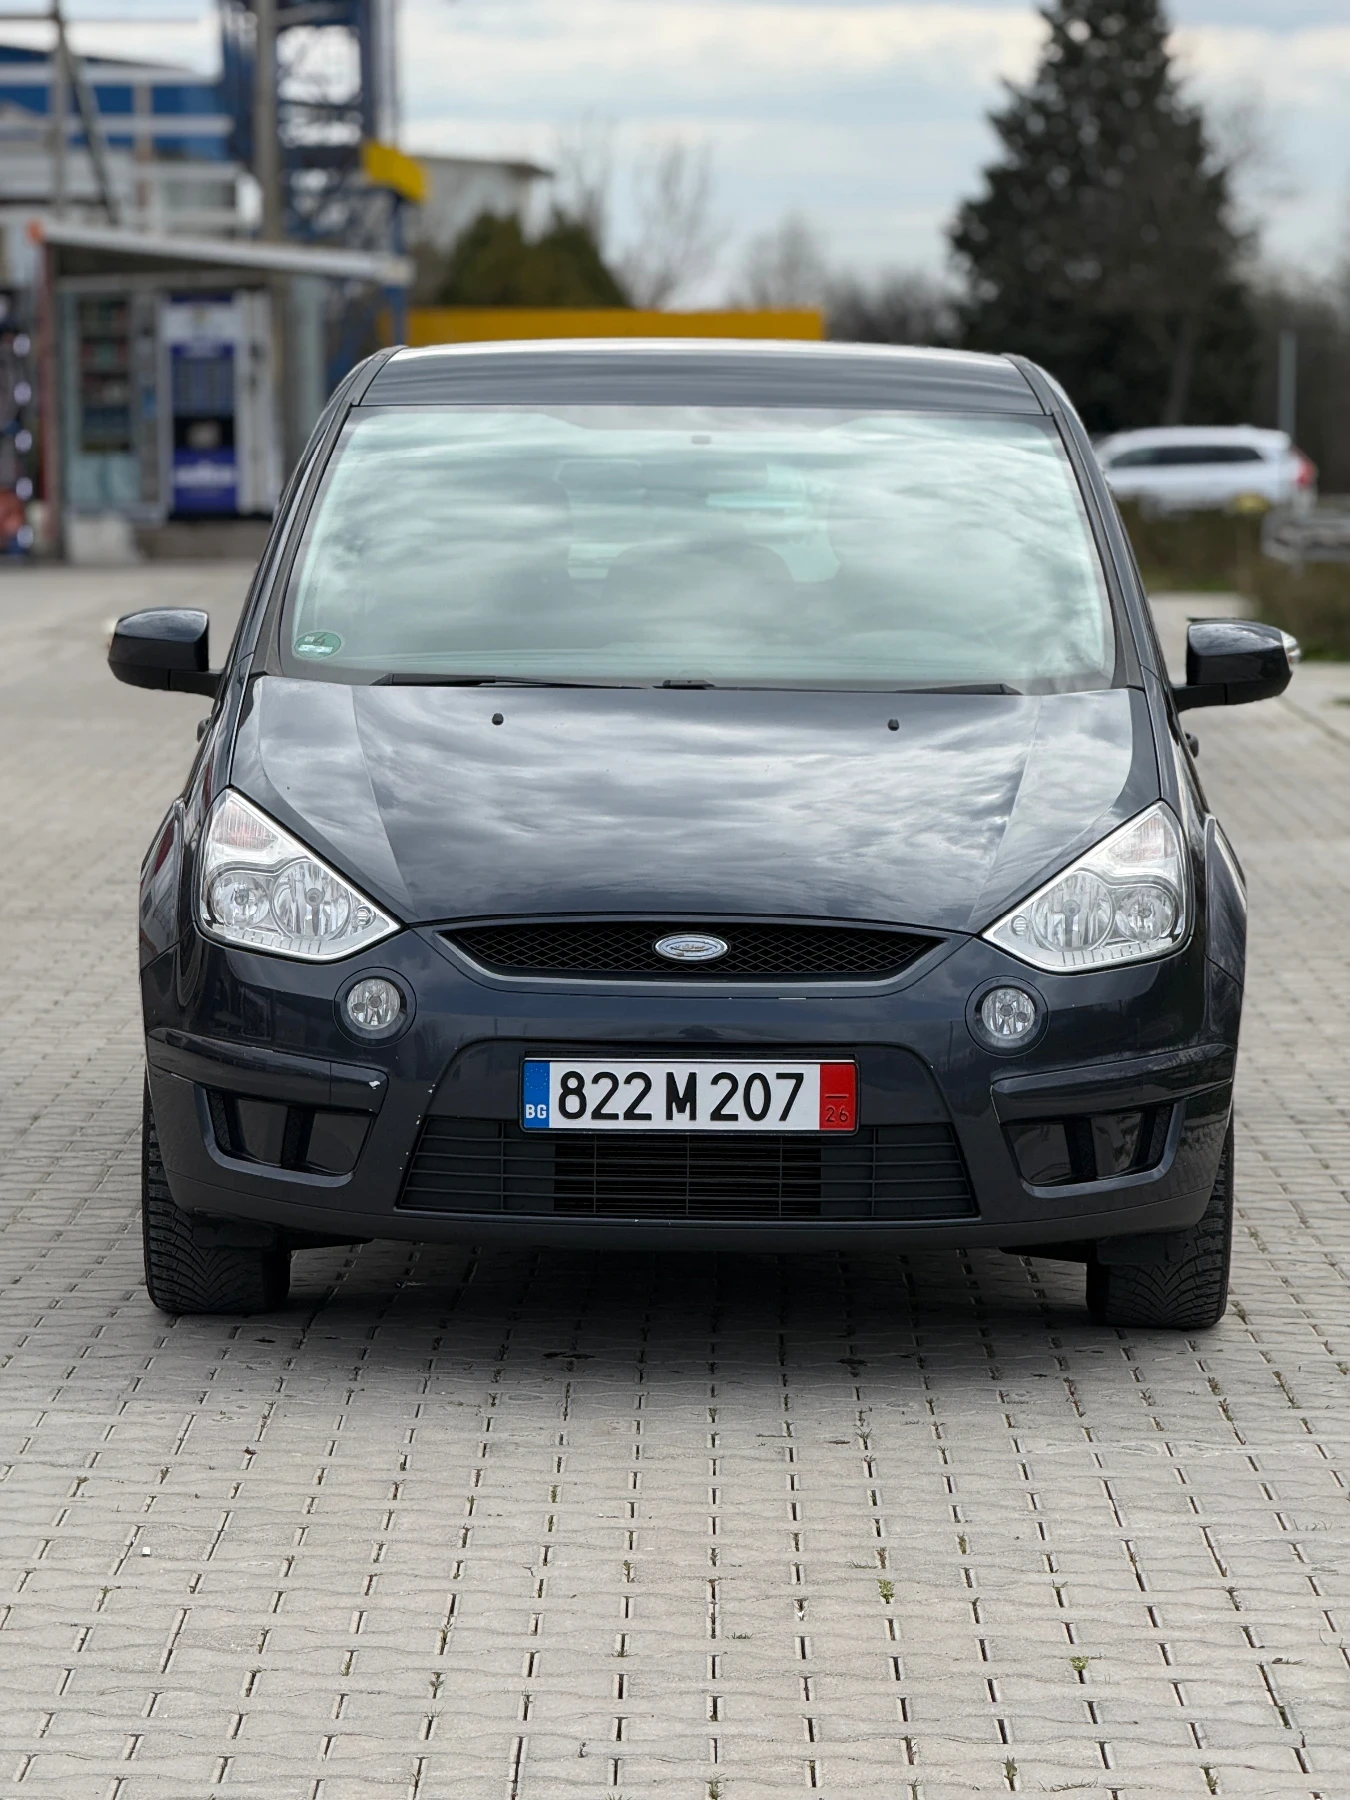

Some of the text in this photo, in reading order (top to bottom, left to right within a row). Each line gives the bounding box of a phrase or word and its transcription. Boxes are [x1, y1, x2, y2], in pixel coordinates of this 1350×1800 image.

[558, 1070, 804, 1122] 822 M 207
[525, 1103, 547, 1119] BG
[825, 1106, 849, 1123] 26
